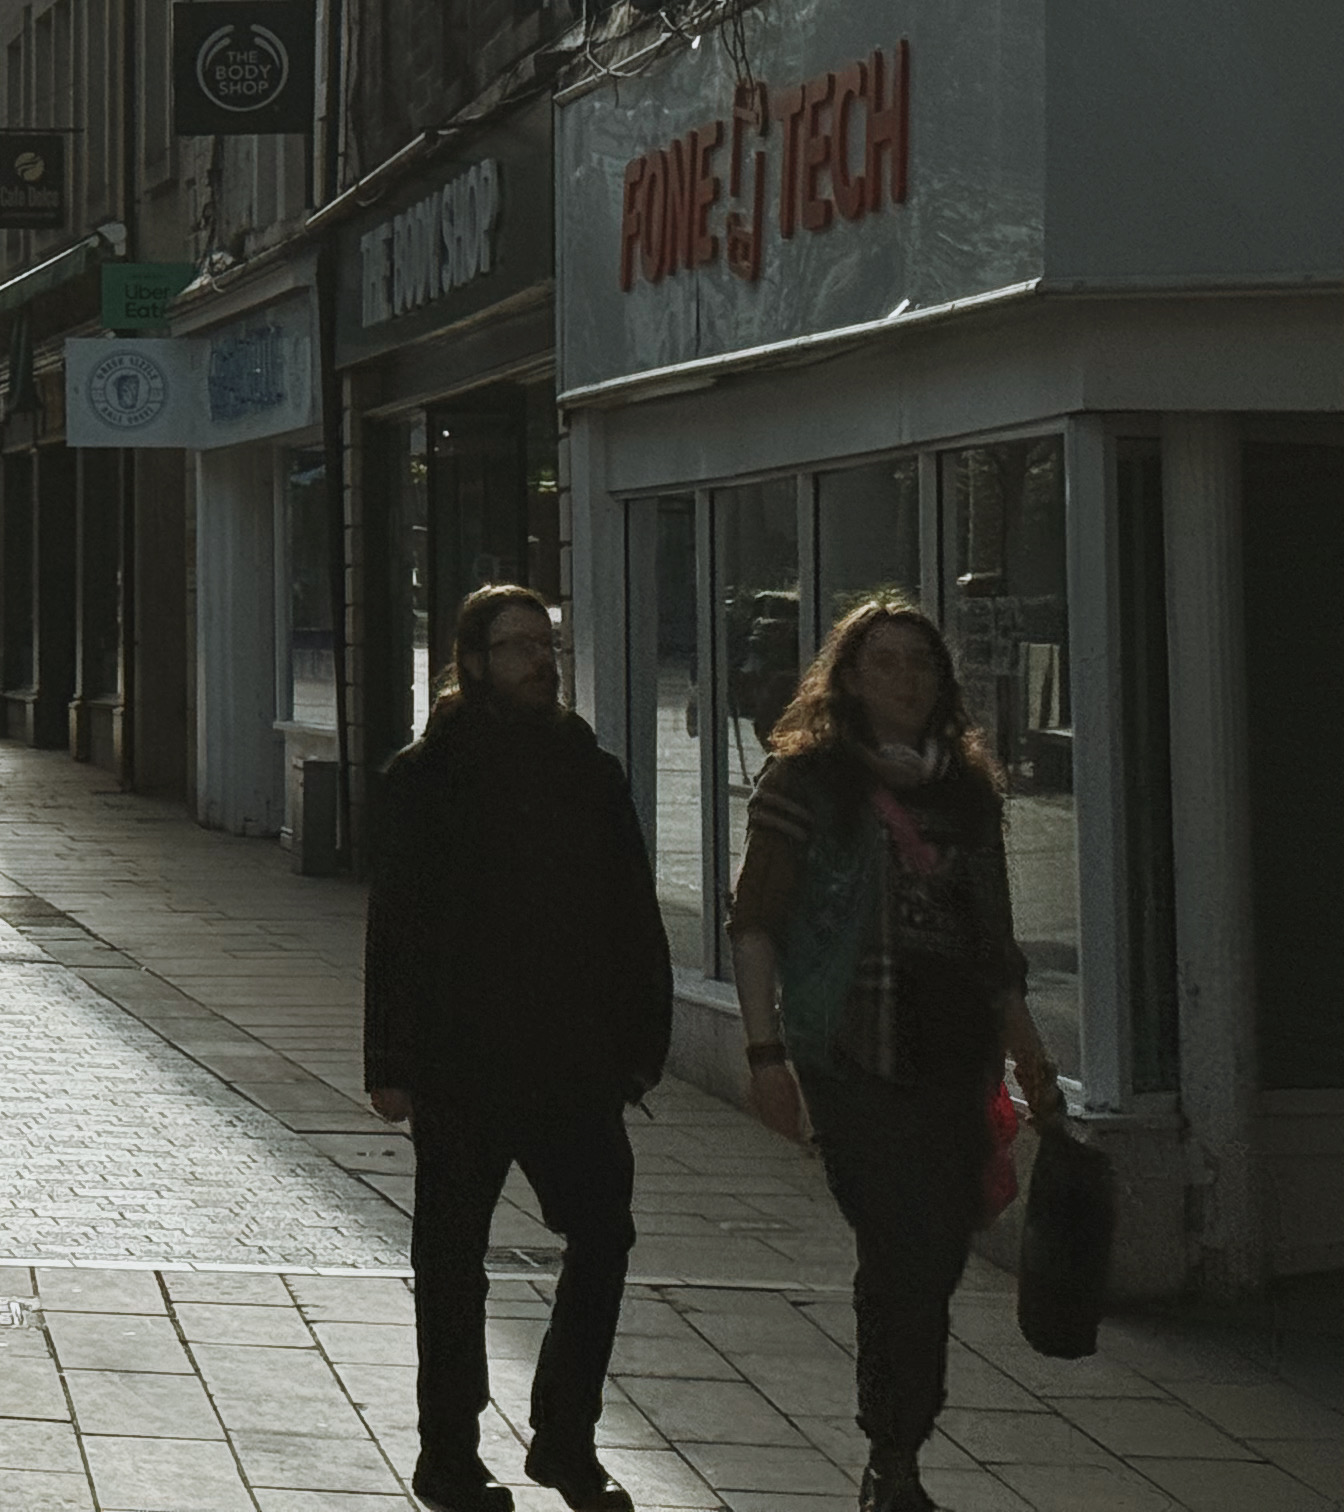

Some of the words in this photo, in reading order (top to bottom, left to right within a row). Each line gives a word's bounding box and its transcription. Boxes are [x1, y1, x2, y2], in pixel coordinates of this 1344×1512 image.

[226, 49, 258, 65] THE
[215, 64, 272, 80] BODY
[218, 80, 269, 96] SHOP
[620, 119, 724, 294] FONE
[767, 38, 911, 242] TECH
[360, 221, 394, 329] THE
[393, 191, 442, 317] BODY
[442, 157, 500, 295] SHOP
[125, 282, 171, 300] Uber
